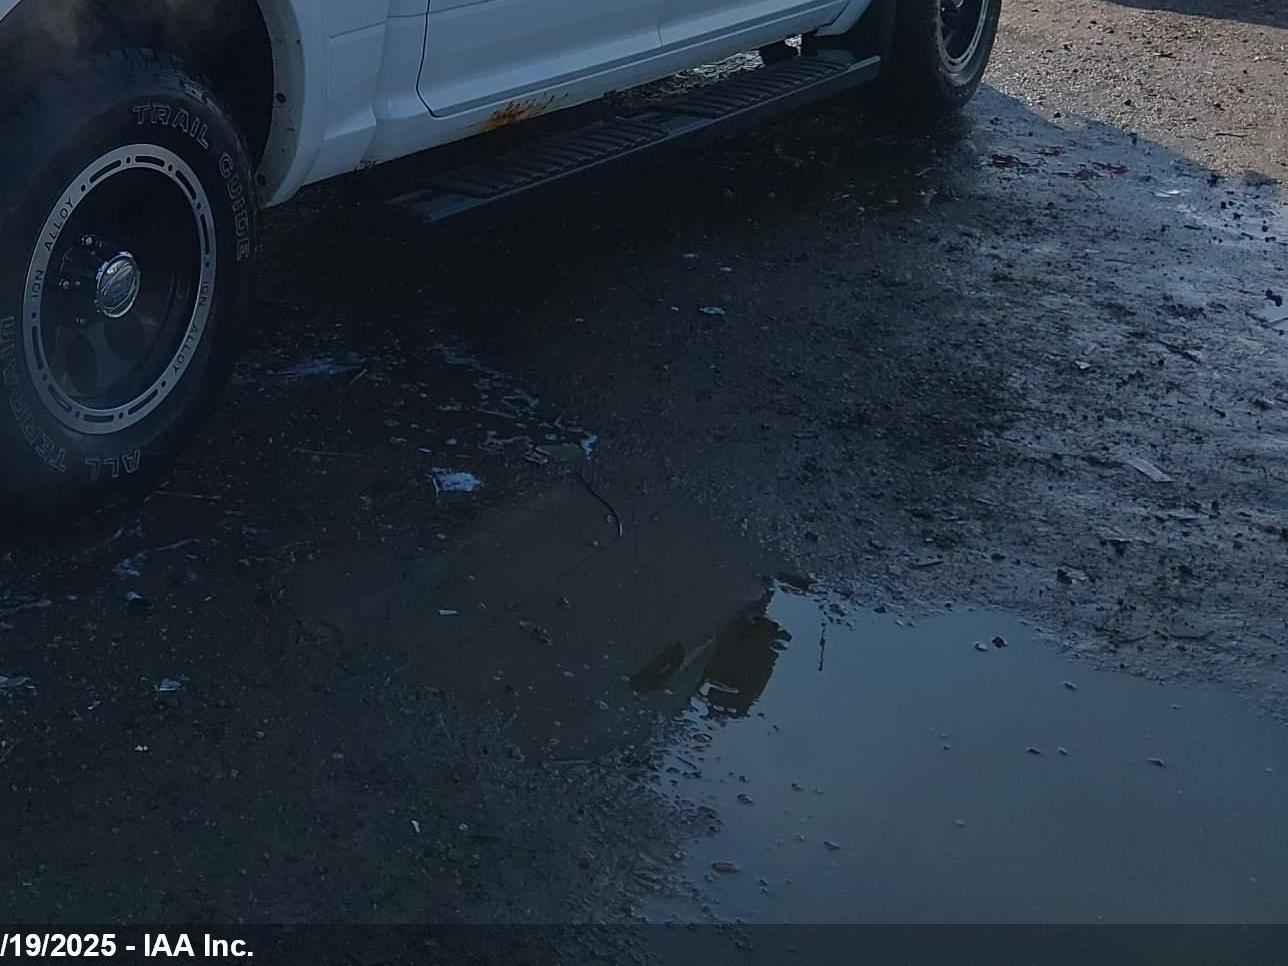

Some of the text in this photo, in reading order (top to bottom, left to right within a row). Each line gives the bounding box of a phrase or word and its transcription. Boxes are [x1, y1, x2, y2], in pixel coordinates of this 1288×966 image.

[31, 196, 74, 298] ION ALLOY
[132, 104, 251, 262] TRAIL GUIDE
[0, 315, 141, 480] ALL TERRAIN
[172, 321, 199, 372] ALLOY
